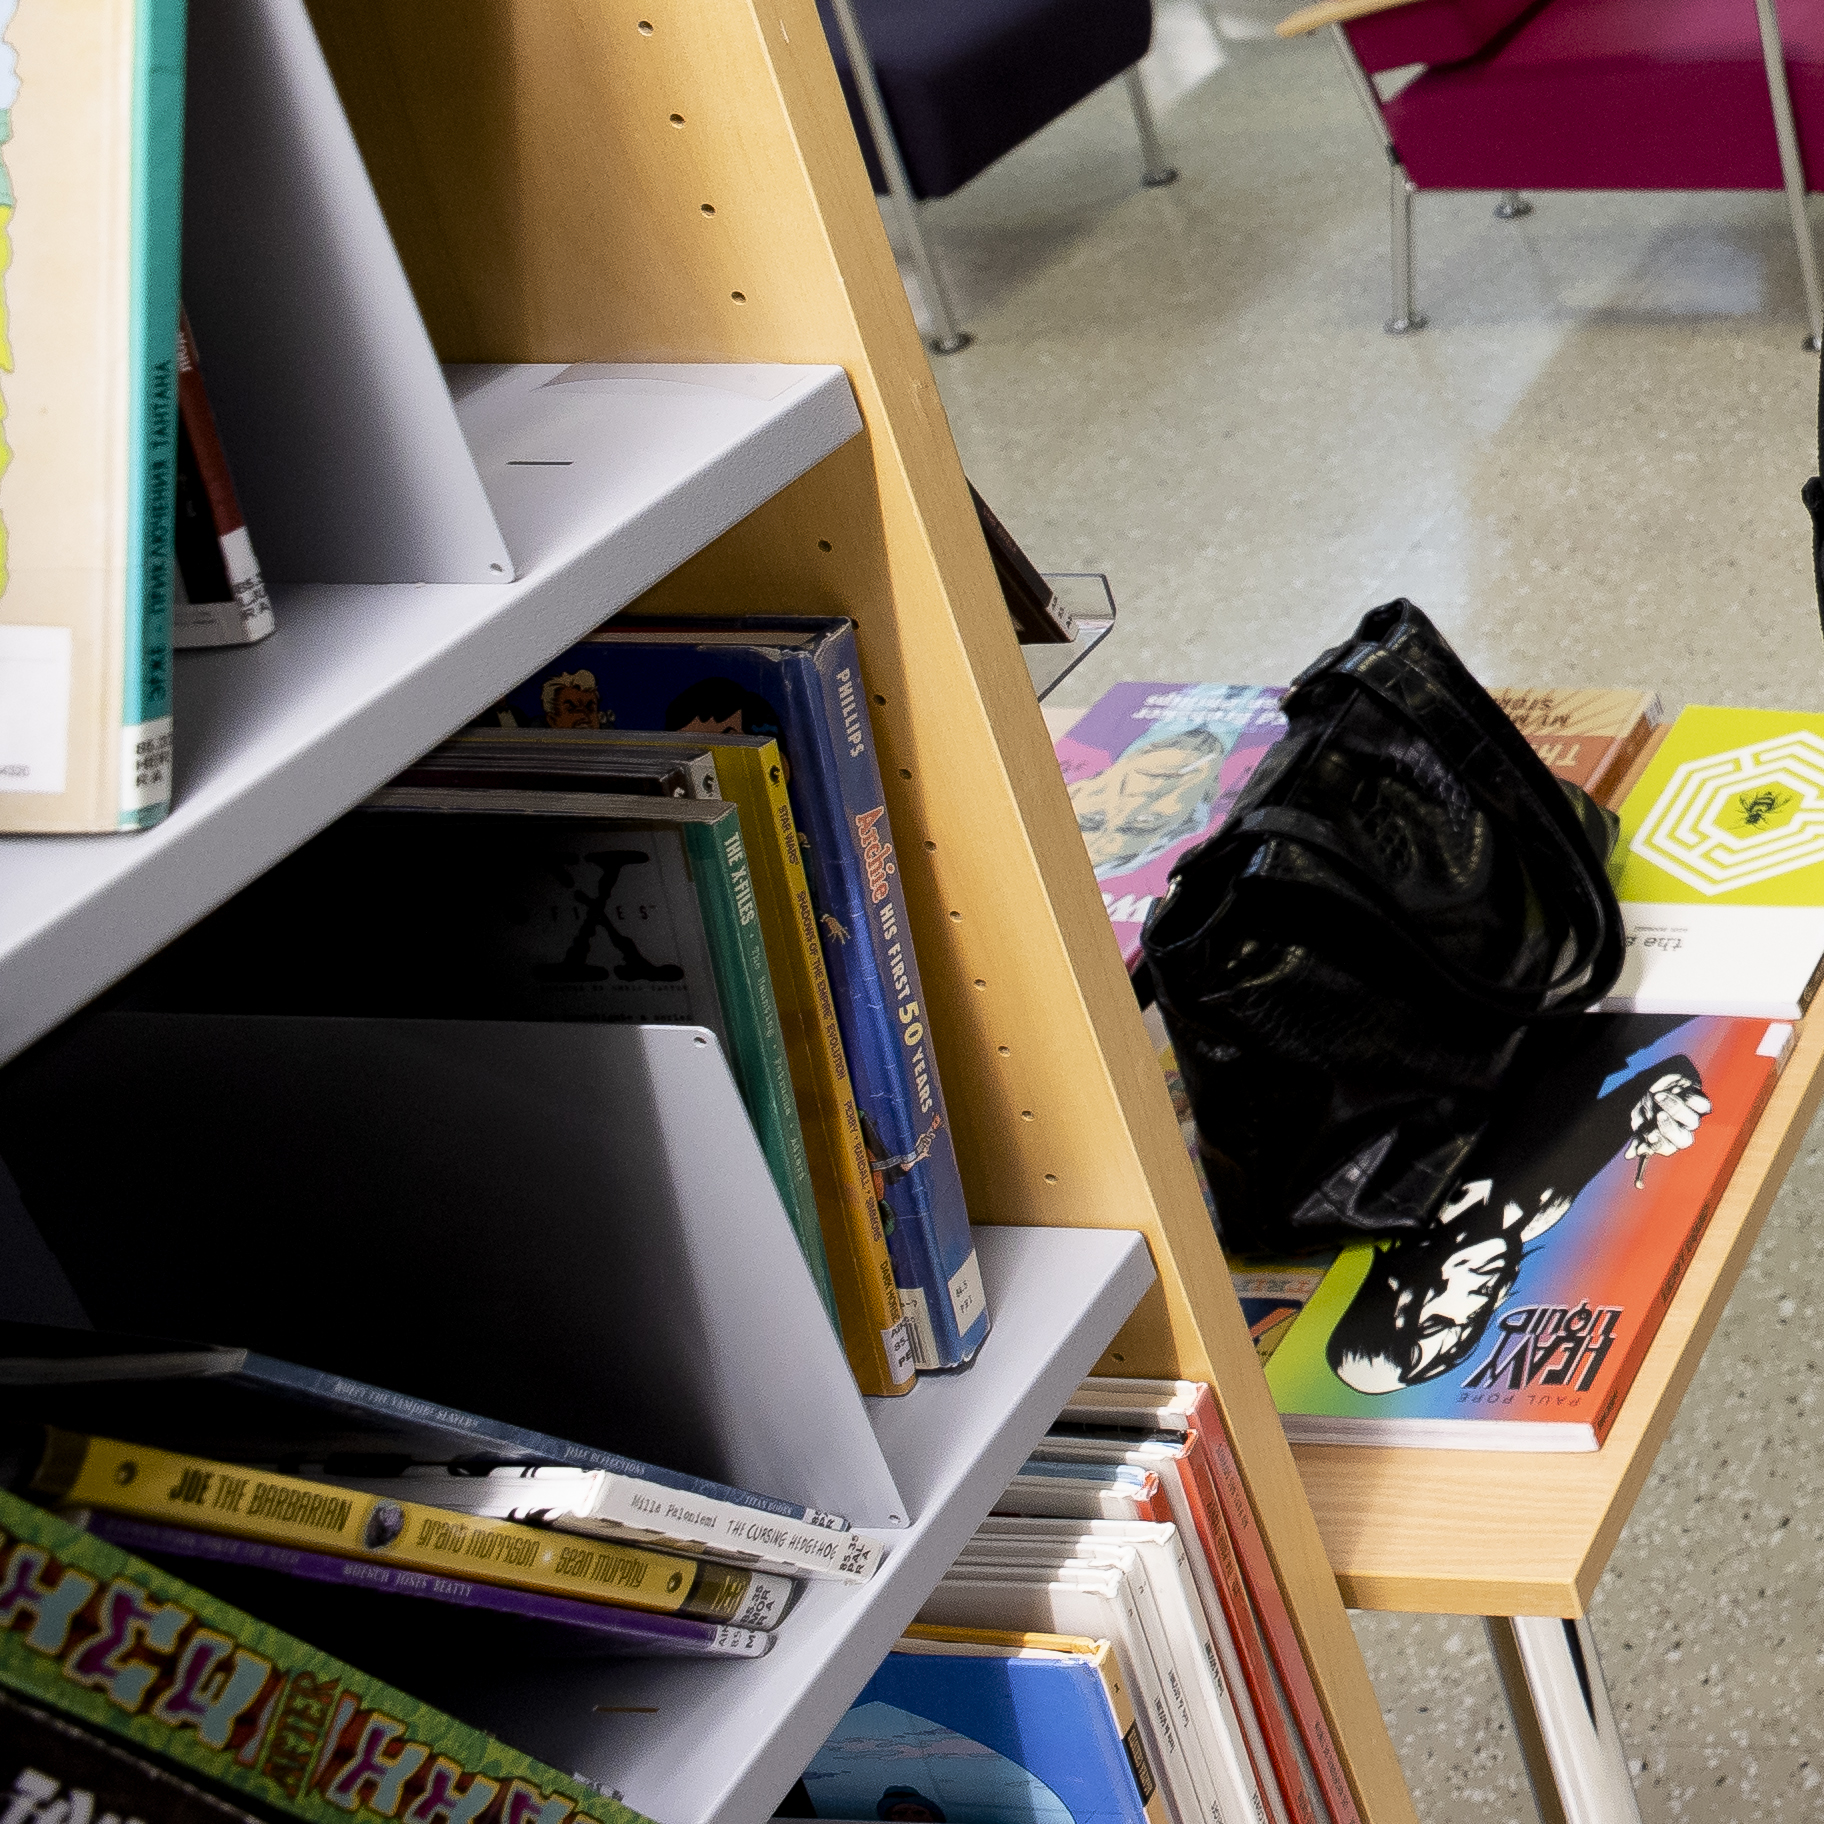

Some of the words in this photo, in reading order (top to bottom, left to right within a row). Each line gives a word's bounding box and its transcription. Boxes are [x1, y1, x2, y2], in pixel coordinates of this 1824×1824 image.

[836, 668, 865, 758] PHILLIPS
[778, 804, 792, 833] STAR
[723, 830, 741, 867] THE
[785, 834, 800, 866] WARS
[855, 805, 896, 903] Archie
[730, 859, 757, 927] X-FILES
[879, 903, 896, 942] HIS
[806, 940, 819, 956] OF
[1643, 935, 1684, 952] the
[810, 957, 825, 979] THE
[886, 940, 912, 1001] FIRST
[898, 998, 924, 1048] 50
[911, 1046, 934, 1115] YEARS
[880, 1262, 894, 1288] DARK
[1499, 1298, 1625, 1339] LIQUID
[1462, 1330, 1616, 1393] HEAVY
[1456, 1392, 1514, 1407] POPE
[1533, 1392, 1582, 1407] PAUL
[168, 1467, 213, 1505] JOE
[212, 1474, 249, 1513] THE
[246, 1481, 353, 1533] BARBARIAN
[725, 1518, 747, 1537] THE
[746, 1522, 787, 1550] CURSING
